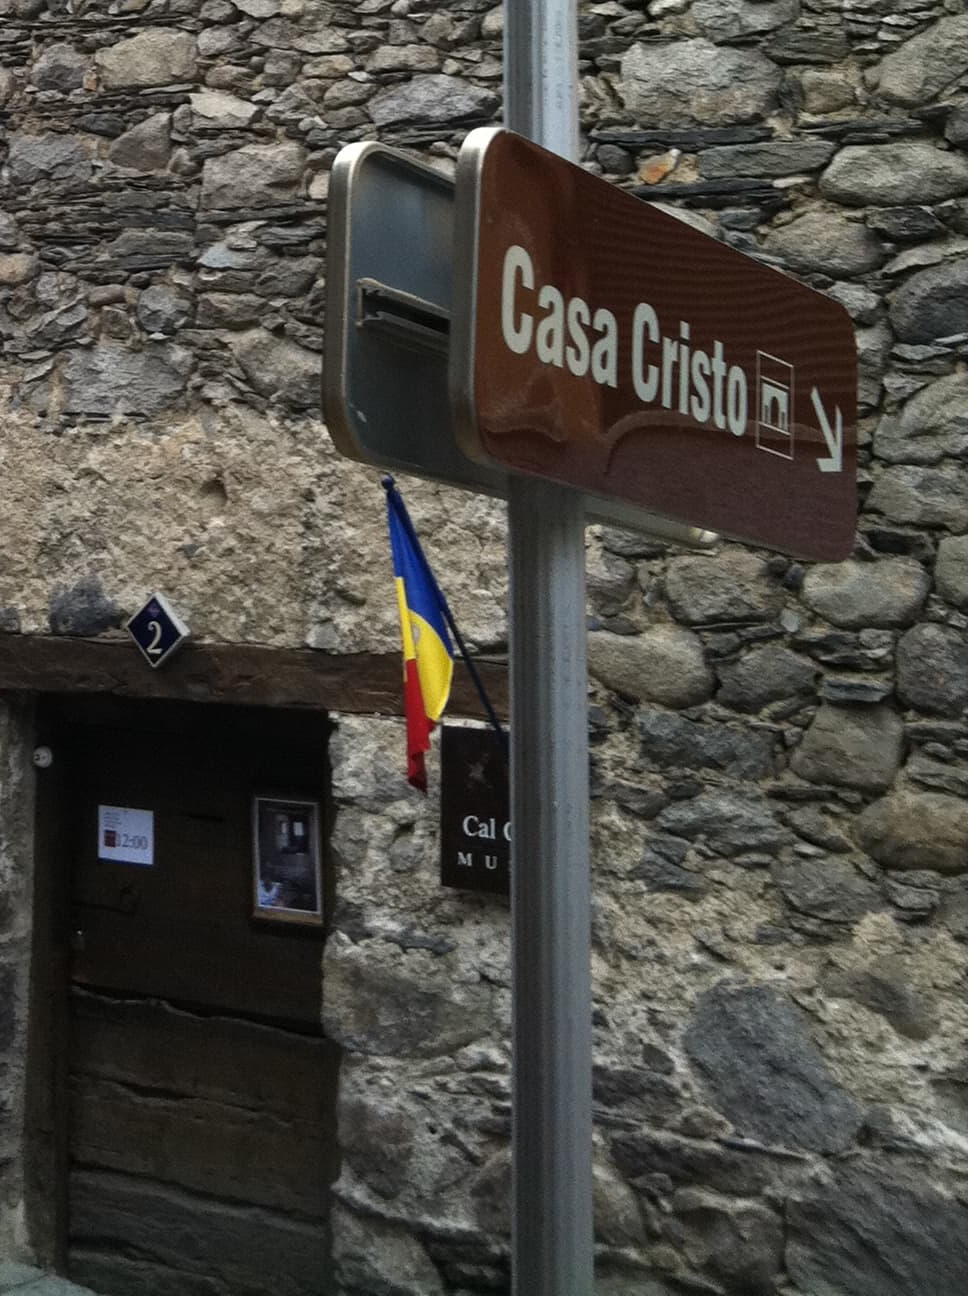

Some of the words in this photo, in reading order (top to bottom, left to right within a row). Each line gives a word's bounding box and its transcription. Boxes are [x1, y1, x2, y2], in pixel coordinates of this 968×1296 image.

[501, 245, 618, 389] Casa
[632, 302, 748, 437] Cristo
[146, 620, 163, 654] 2
[462, 815, 496, 840] Cal
[457, 851, 512, 871] MU
